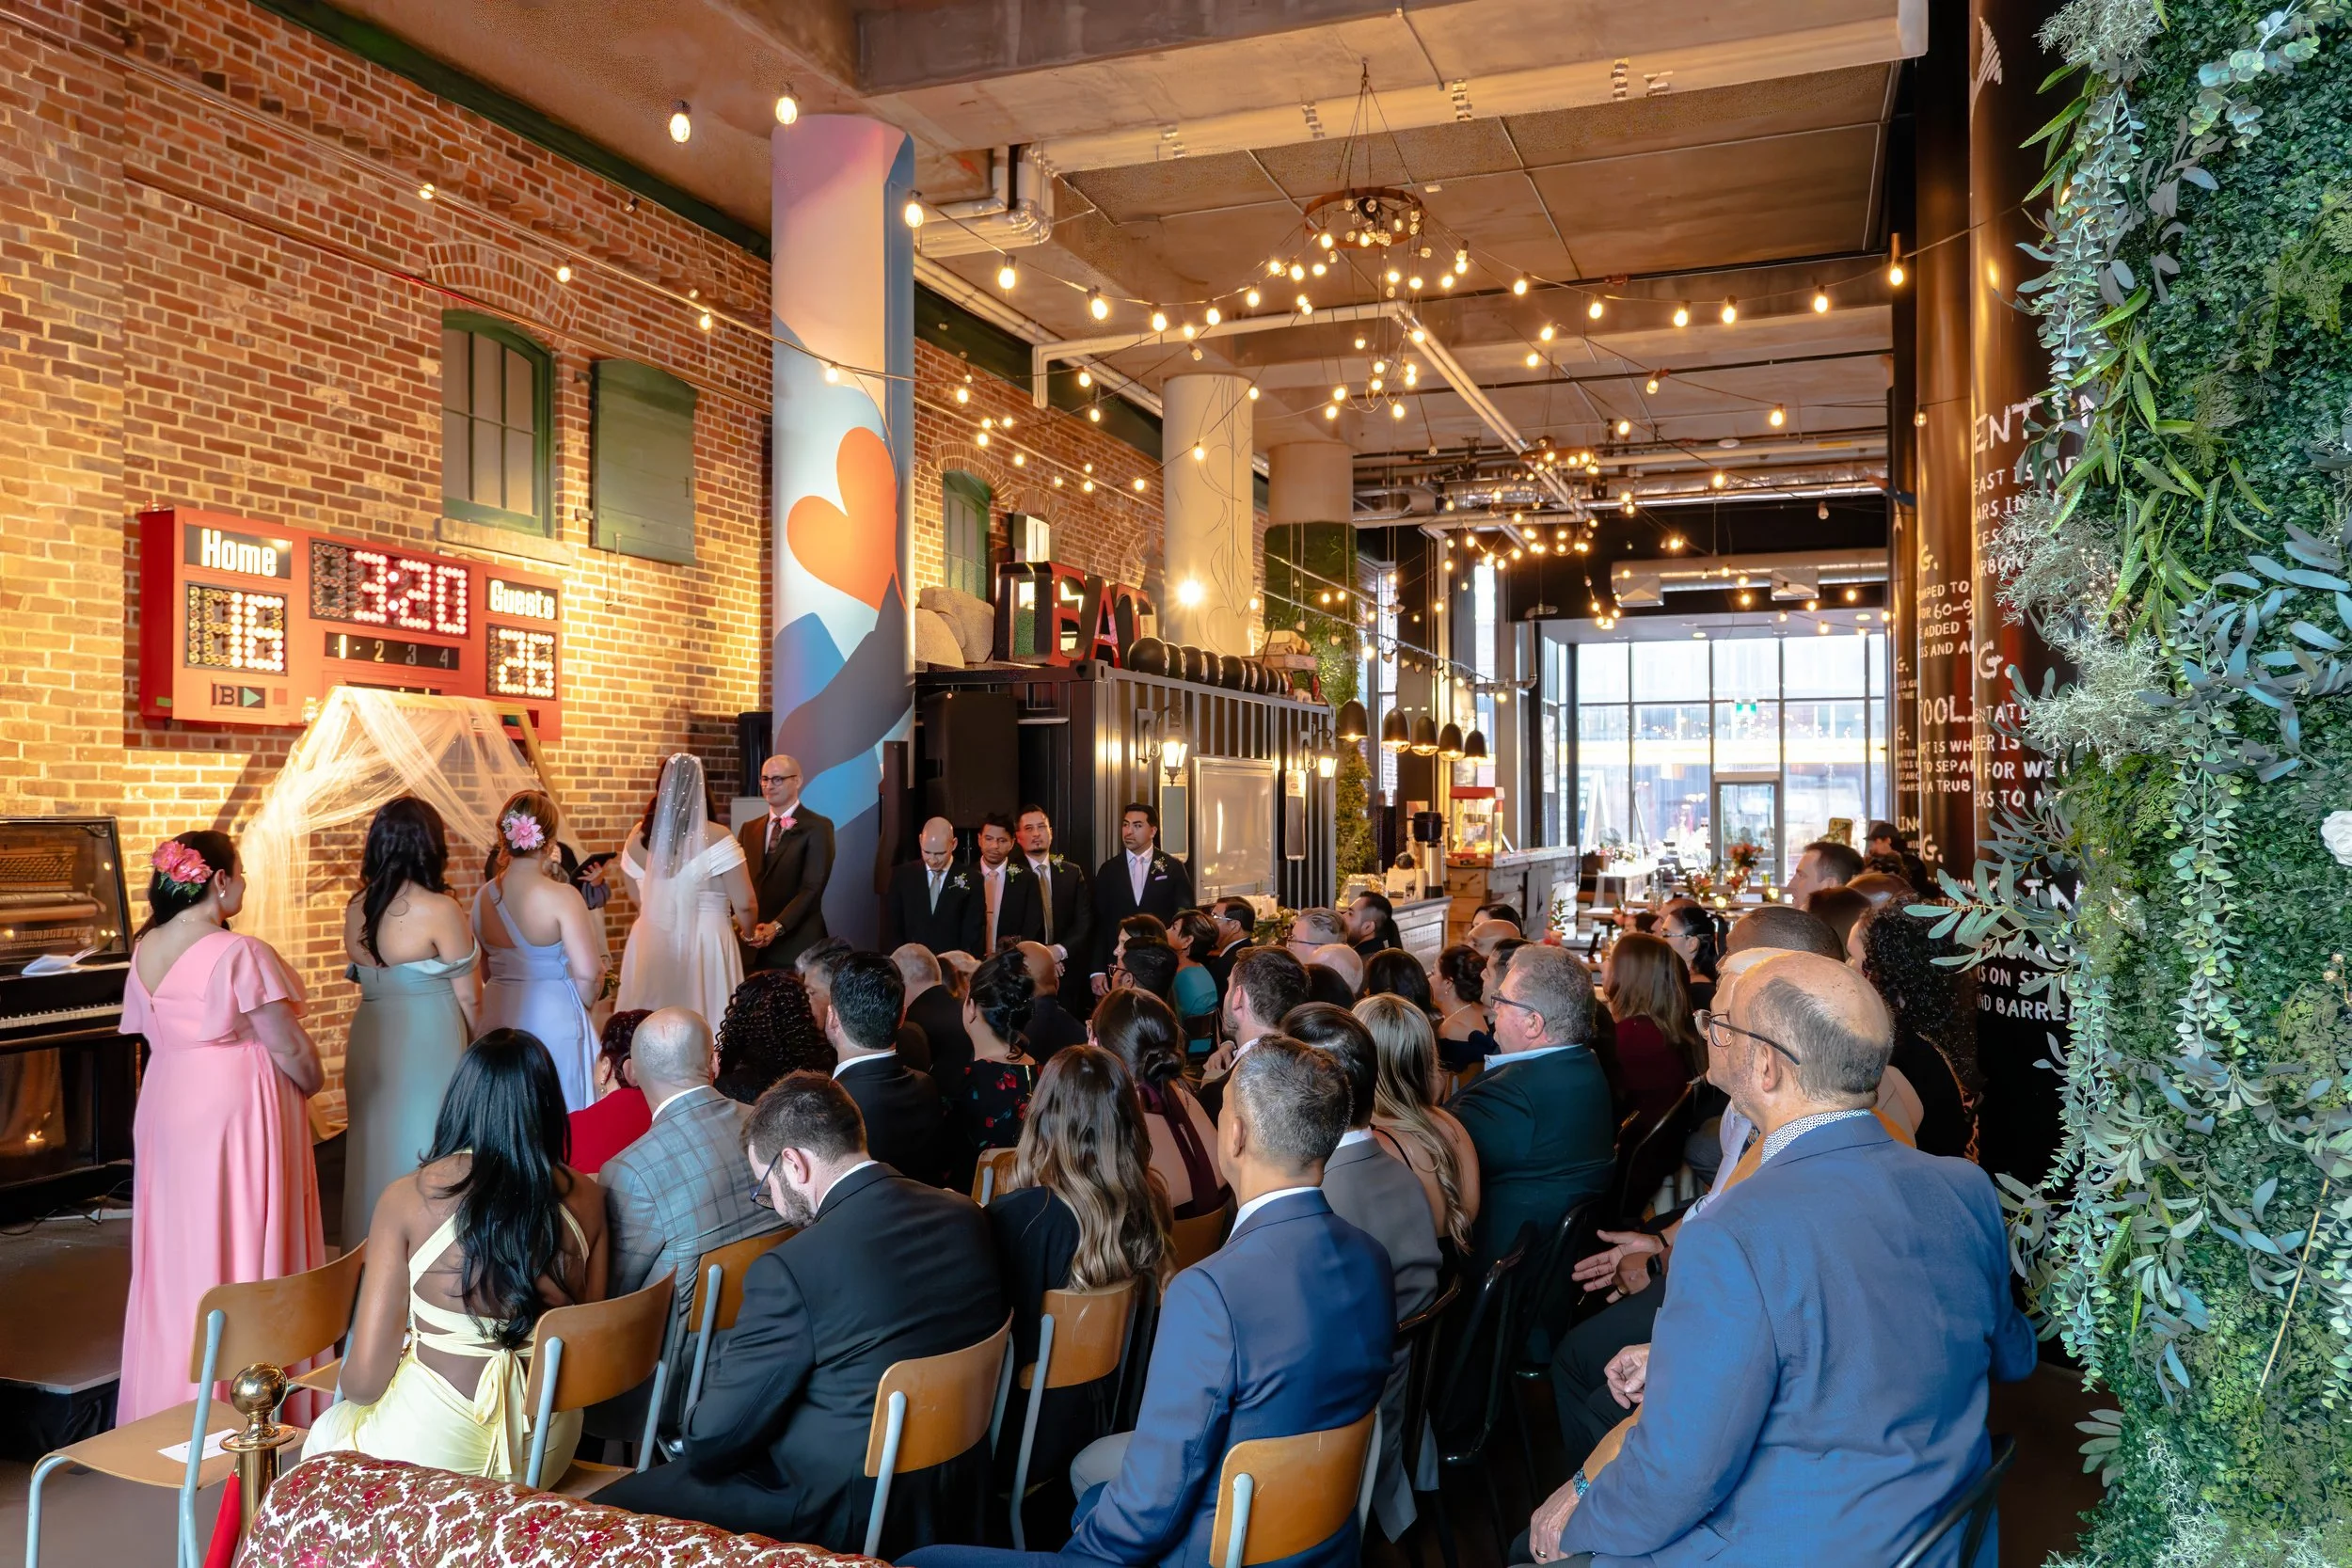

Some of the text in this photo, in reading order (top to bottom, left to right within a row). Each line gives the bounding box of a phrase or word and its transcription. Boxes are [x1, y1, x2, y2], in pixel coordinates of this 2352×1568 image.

[201, 529, 278, 578] Home
[1949, 580, 1969, 594] TO
[489, 579, 555, 620] Guests
[1044, 562, 1153, 669] EAT
[230, 592, 284, 672] 16
[1924, 621, 1960, 640] ADDED
[374, 641, 385, 662] 2
[405, 644, 417, 665] 3
[439, 648, 449, 668] 4
[1930, 642, 1953, 657] AND
[1933, 740, 1946, 753] IS
[1984, 761, 2015, 780] FOR
[1936, 780, 1971, 793] TRUB
[1999, 790, 2026, 807] TO
[1990, 967, 2010, 988] ON
